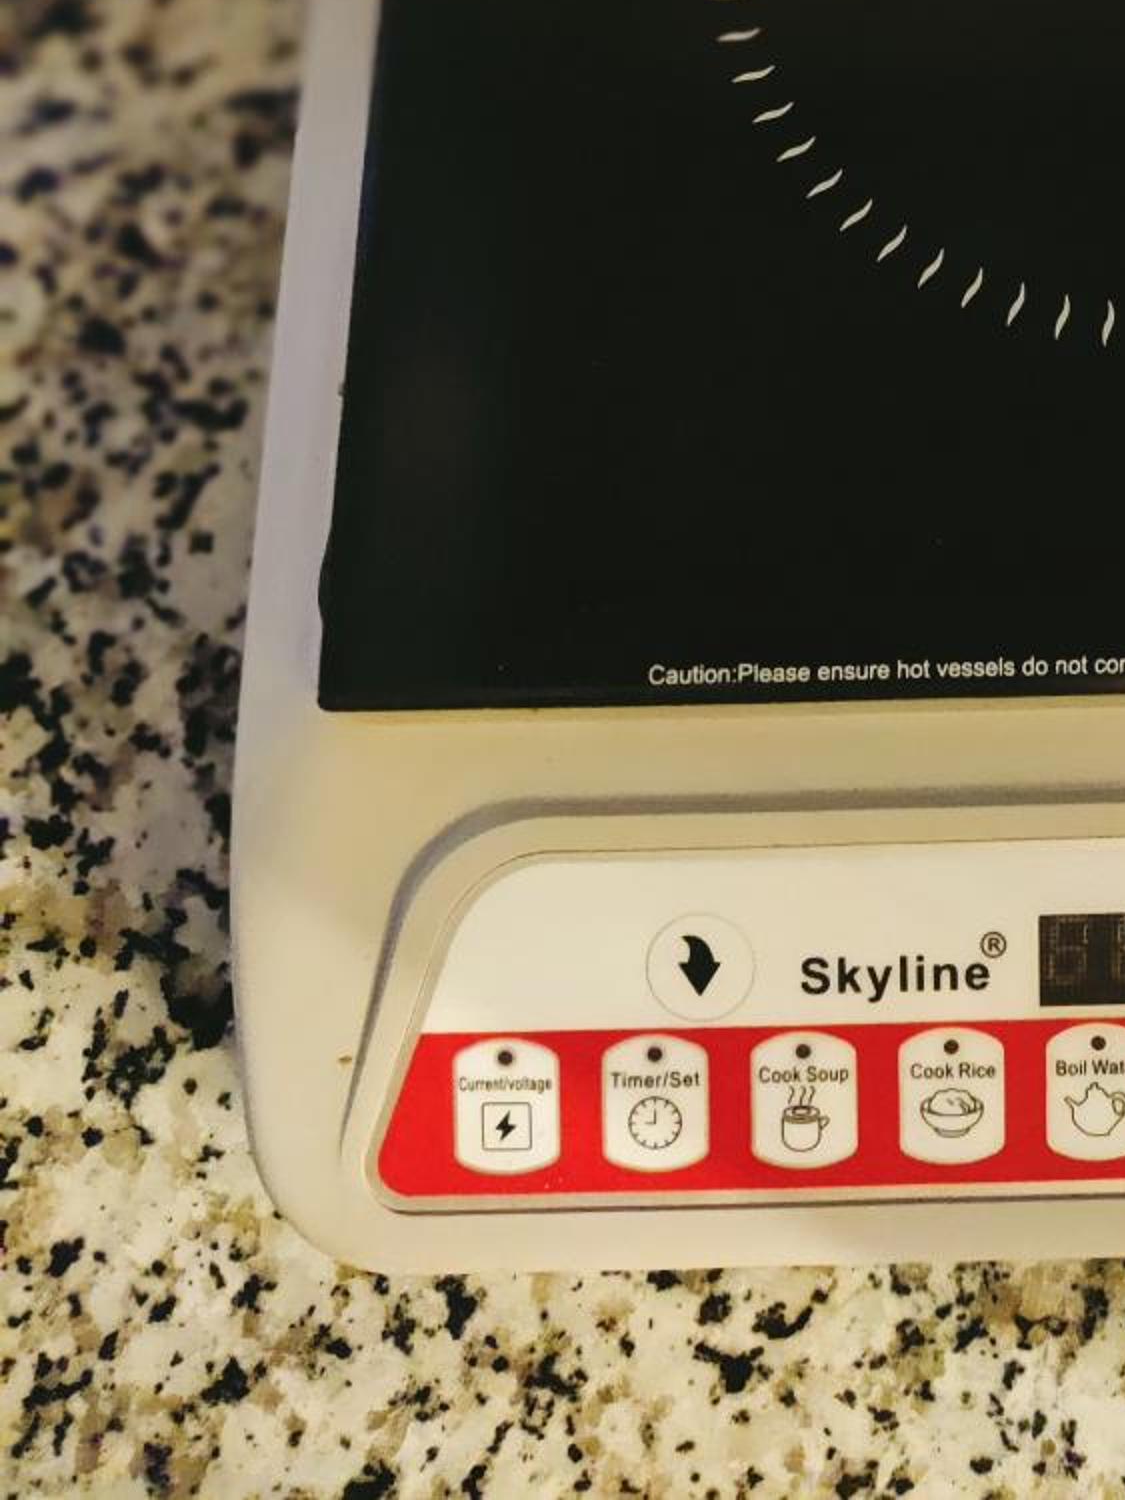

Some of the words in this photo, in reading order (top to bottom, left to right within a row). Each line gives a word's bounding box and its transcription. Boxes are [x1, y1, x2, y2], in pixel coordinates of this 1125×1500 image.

[817, 665, 890, 681] ensure
[896, 660, 931, 679] hot
[936, 659, 1015, 678] vessels
[1021, 656, 1049, 676] do
[1055, 656, 1088, 675] not
[758, 1066, 801, 1084] Cook
[806, 1065, 850, 1083] Soup
[910, 1062, 954, 1080] Cook
[959, 1062, 996, 1079] Rice
[1055, 1059, 1087, 1077] Boil
[611, 1070, 701, 1089] Timer/Set
